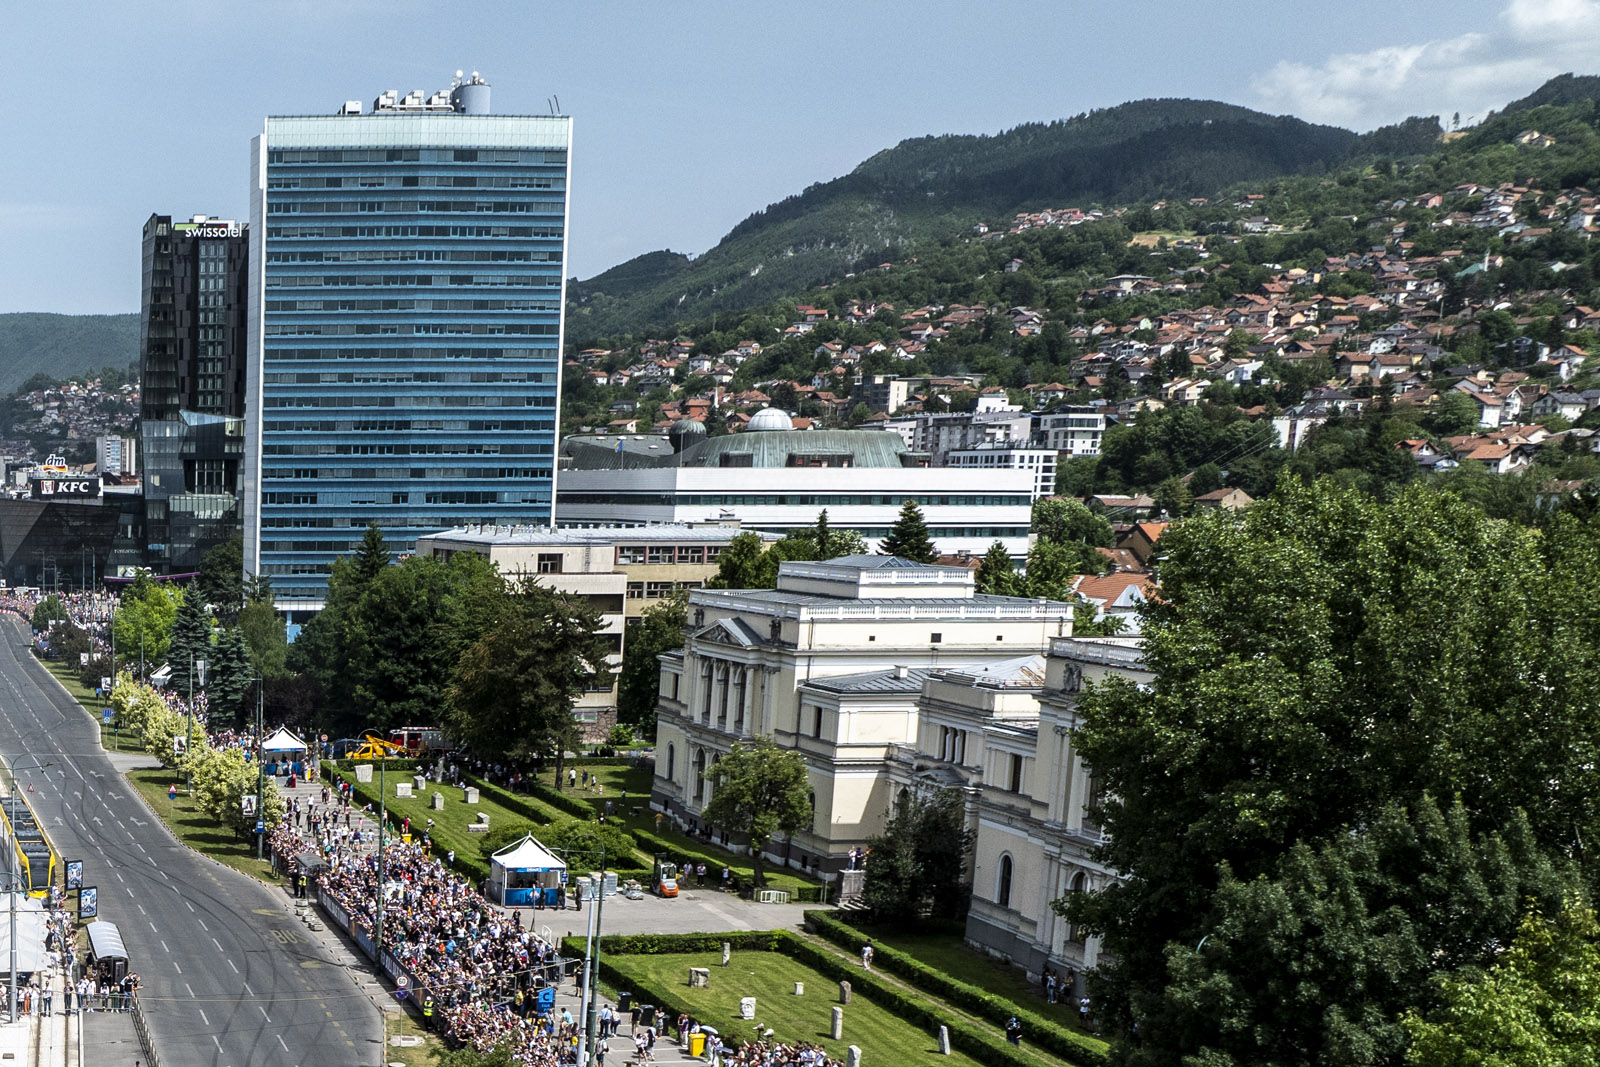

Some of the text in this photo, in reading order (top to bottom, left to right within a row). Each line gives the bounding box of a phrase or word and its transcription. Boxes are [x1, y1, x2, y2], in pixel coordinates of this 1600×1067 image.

[47, 455, 64, 466] dm
[57, 481, 90, 493] KFC
[543, 992, 550, 1001] C
